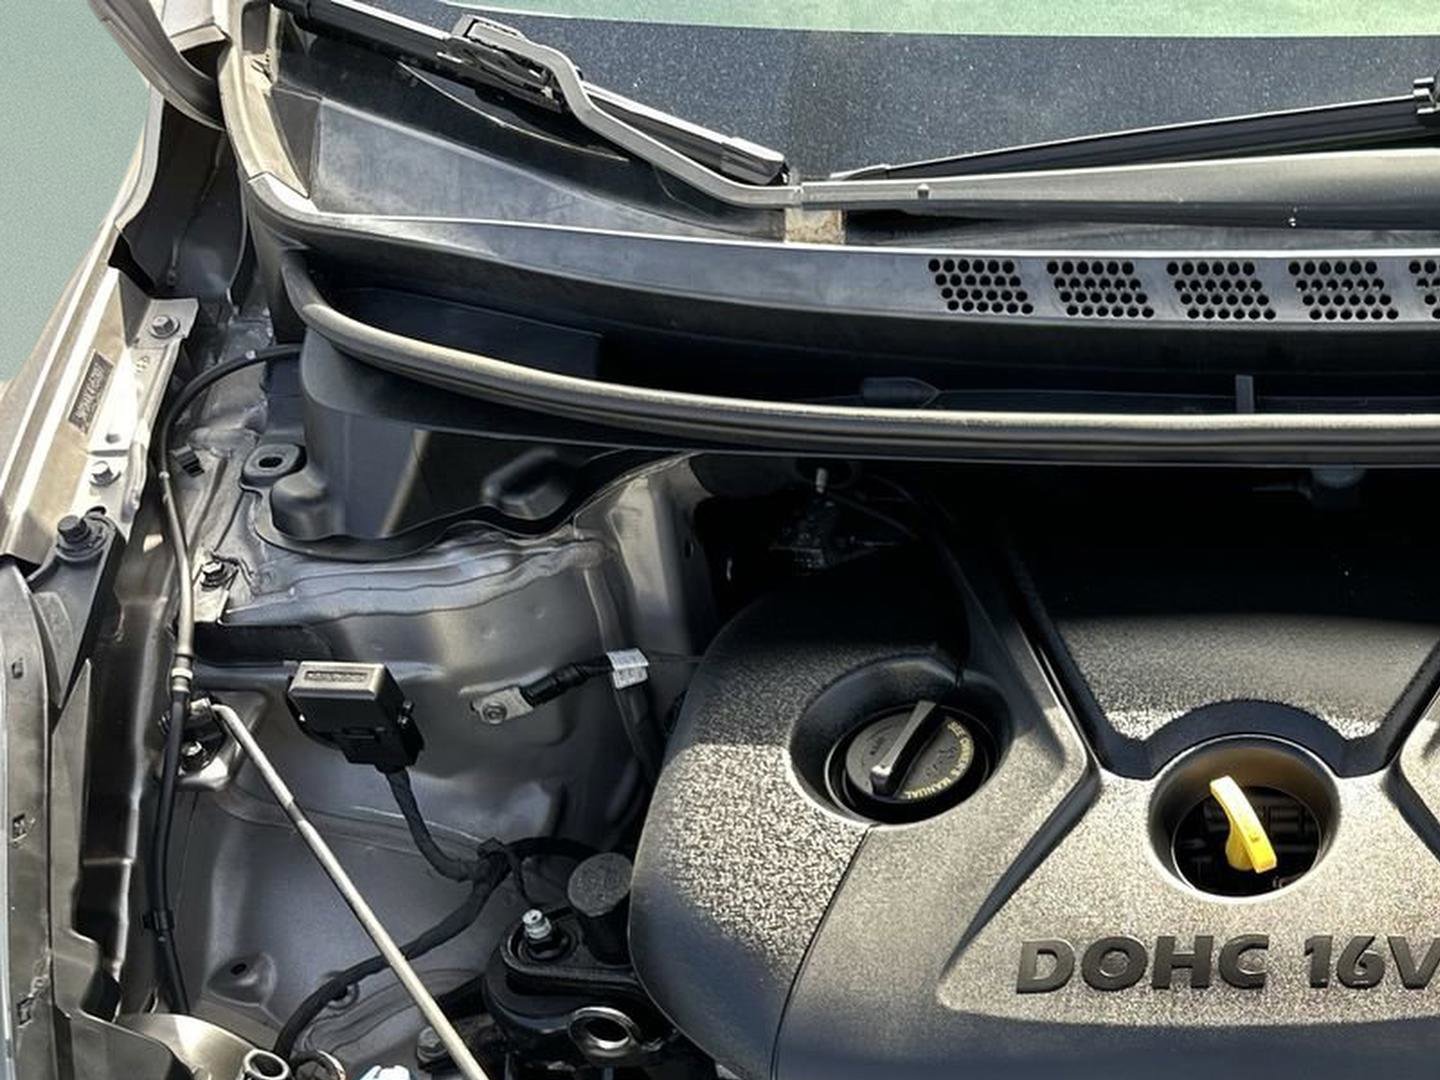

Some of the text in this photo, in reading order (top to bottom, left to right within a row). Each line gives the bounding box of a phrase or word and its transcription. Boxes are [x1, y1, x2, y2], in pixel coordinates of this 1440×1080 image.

[947, 721, 965, 738] SEE
[904, 776, 952, 800] MANUAL
[1016, 934, 1270, 994] DOHC
